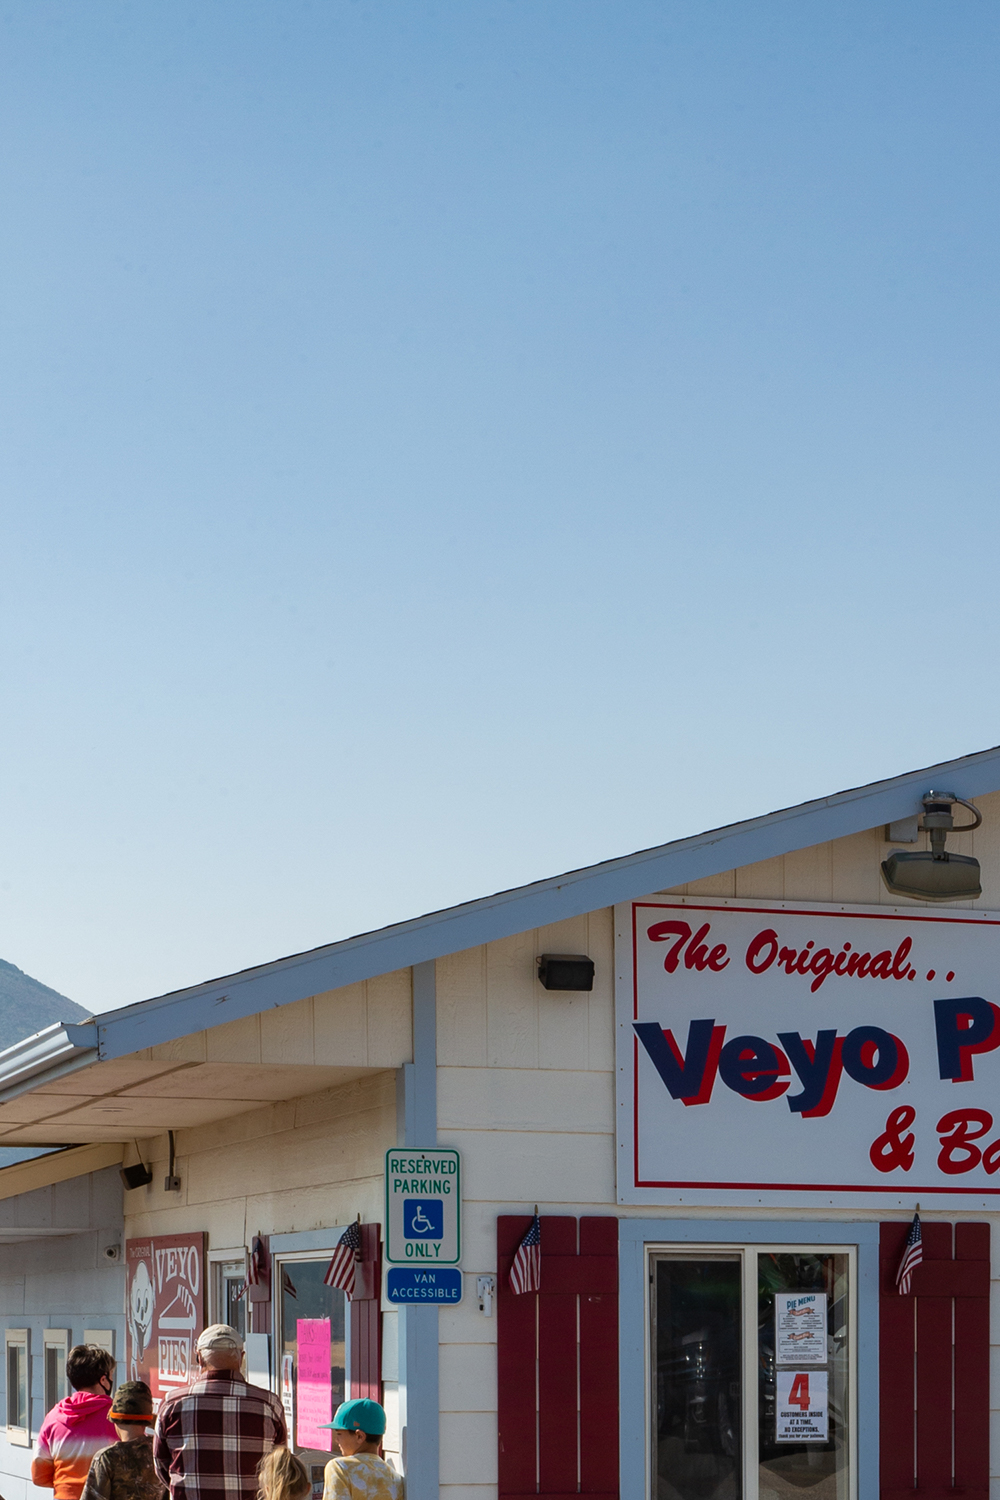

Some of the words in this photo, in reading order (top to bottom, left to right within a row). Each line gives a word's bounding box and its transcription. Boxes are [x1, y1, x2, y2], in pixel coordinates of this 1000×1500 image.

[647, 920, 730, 974] The
[632, 1019, 909, 1118] Veyo
[870, 1105, 916, 1173] &
[391, 1159, 456, 1174] RESERVED
[394, 1179, 450, 1194] PARKING
[405, 1243, 441, 1257] ONLY
[155, 1246, 199, 1296] VEYO
[414, 1274, 435, 1283] VAN
[392, 1288, 457, 1298] ACCESSIBLE
[787, 1300, 796, 1309] PIE
[798, 1296, 815, 1306] MENU
[160, 1340, 187, 1379] PIES
[789, 1374, 810, 1410] 4
